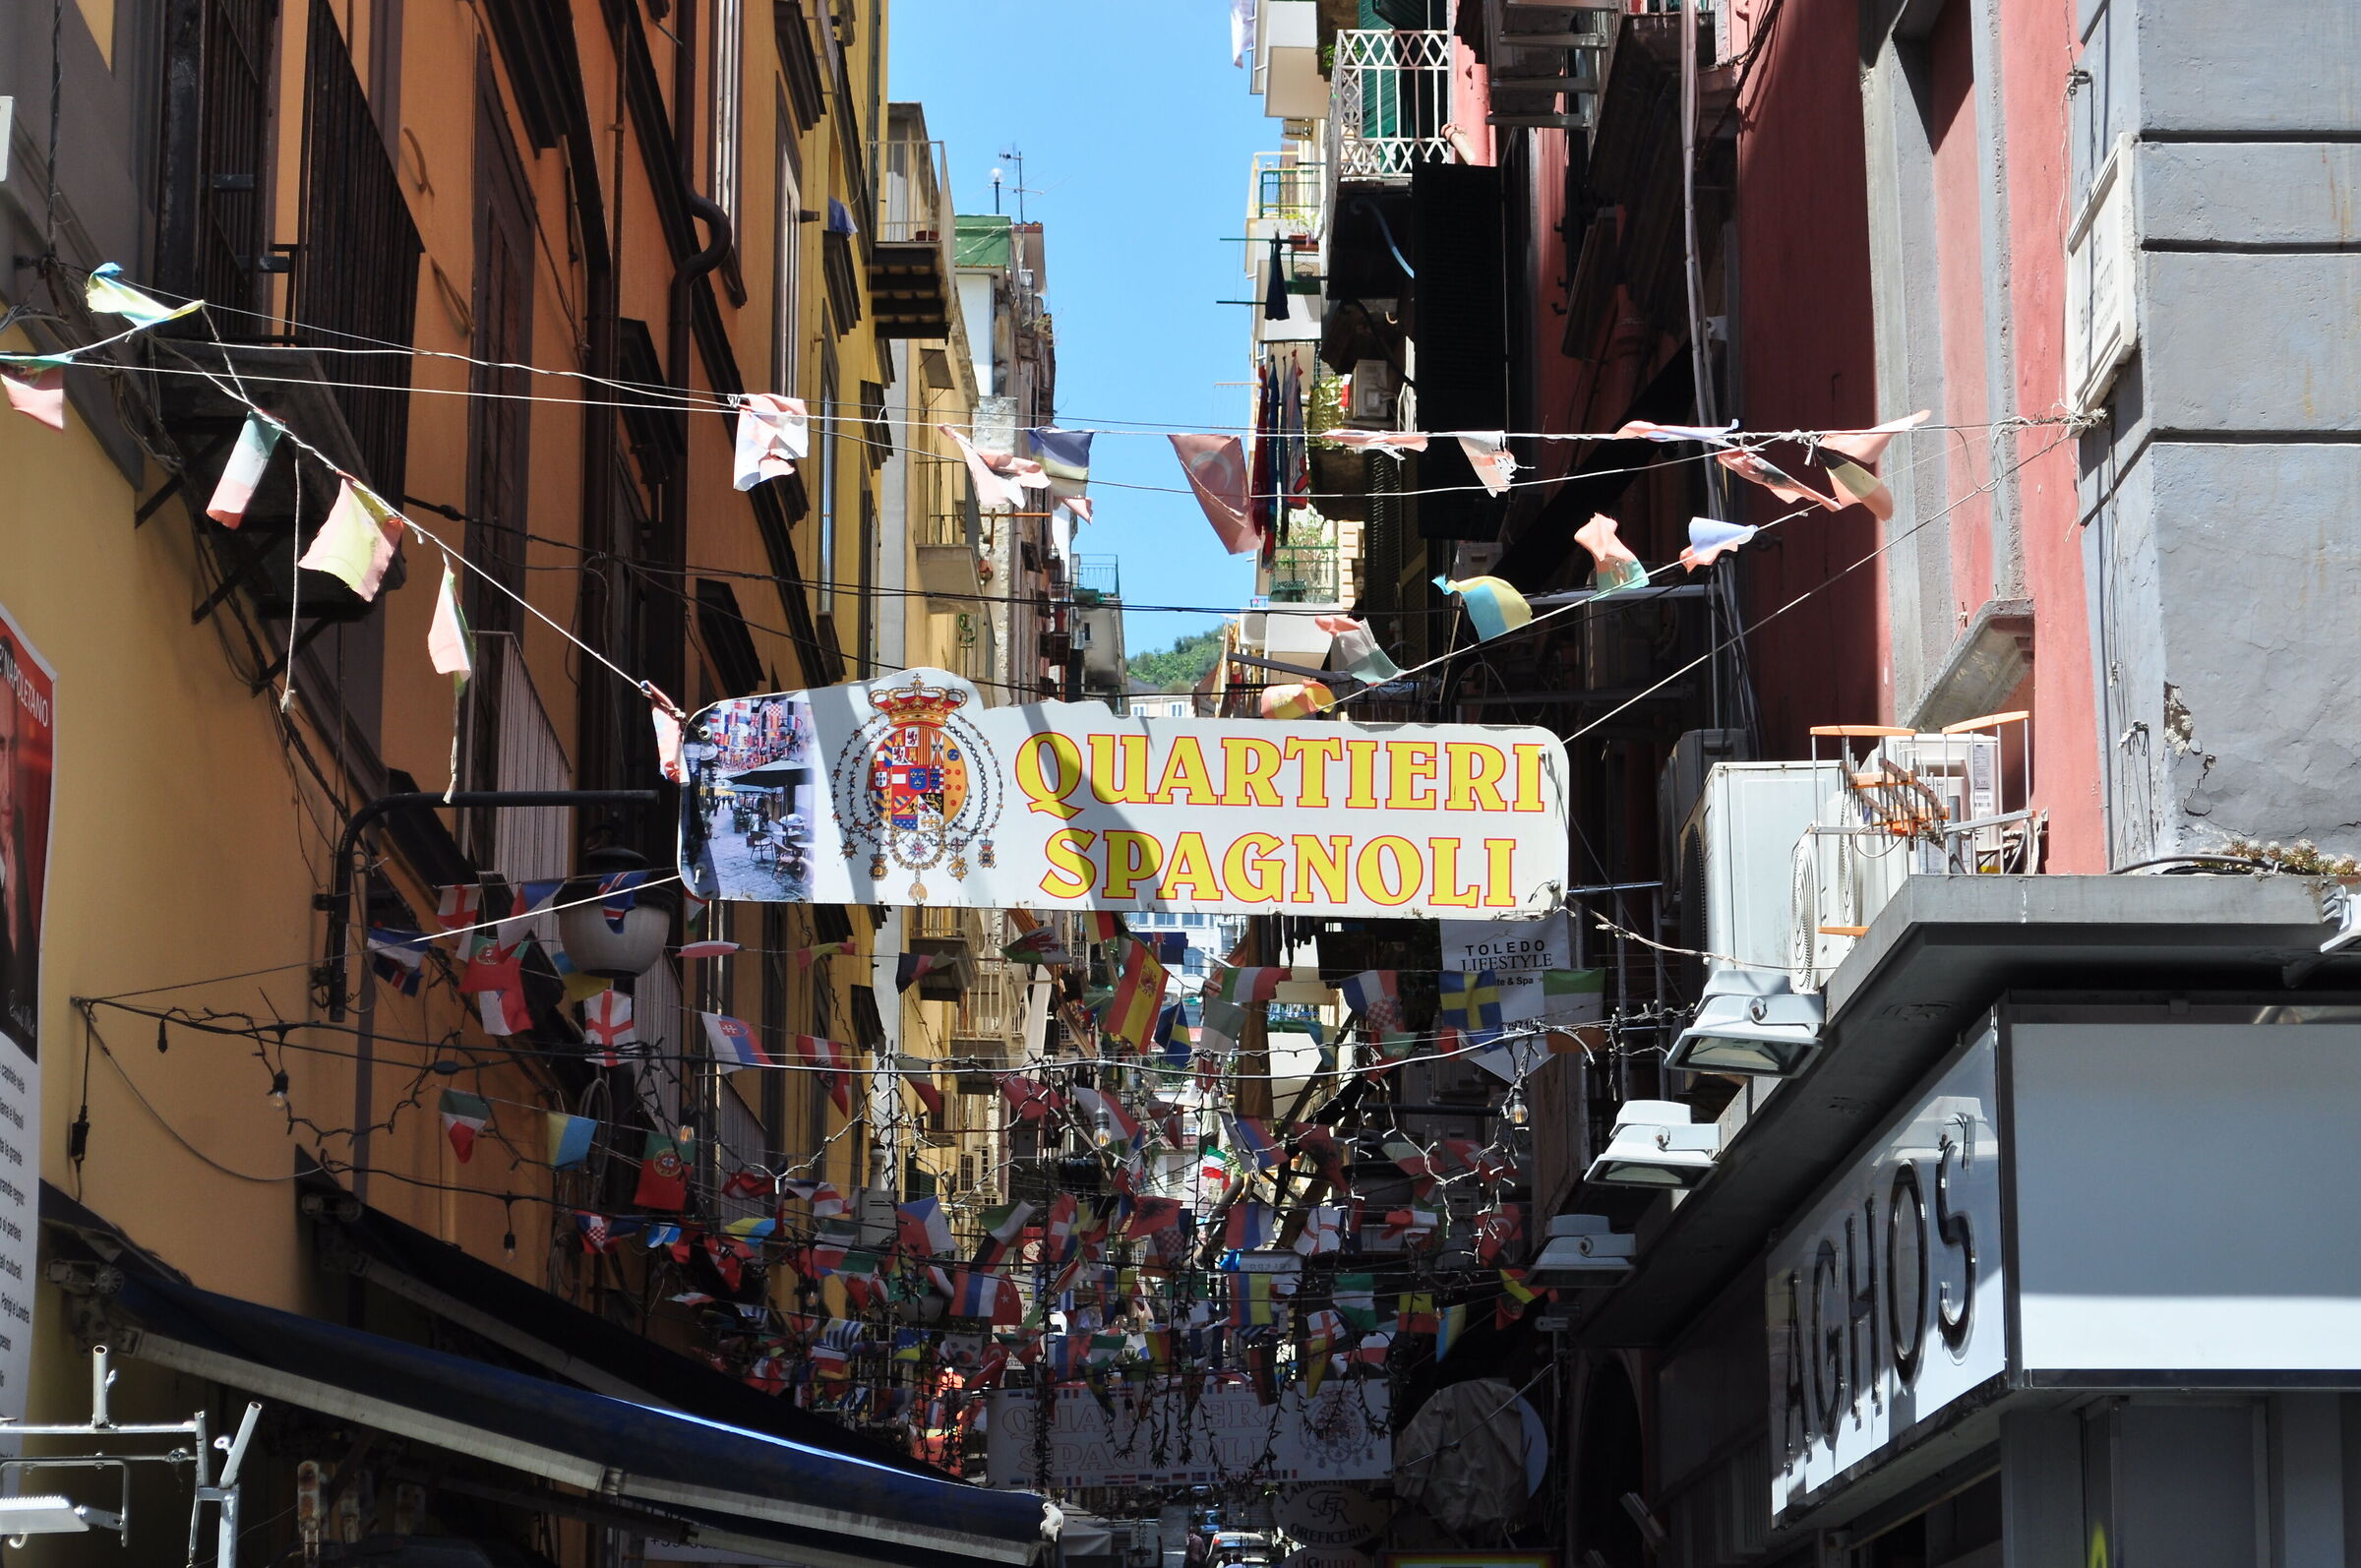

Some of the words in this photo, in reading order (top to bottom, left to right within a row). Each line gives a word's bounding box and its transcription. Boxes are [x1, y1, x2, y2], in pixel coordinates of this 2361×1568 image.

[1015, 730, 1545, 820] QUARTIERI
[1039, 827, 1516, 908] SPAGNOLI
[1465, 940, 1544, 956] TOLEDO
[1461, 954, 1553, 971] LIFESTYLE
[1516, 976, 1534, 987] Spa
[1290, 1523, 1371, 1544] OREFICERIA
